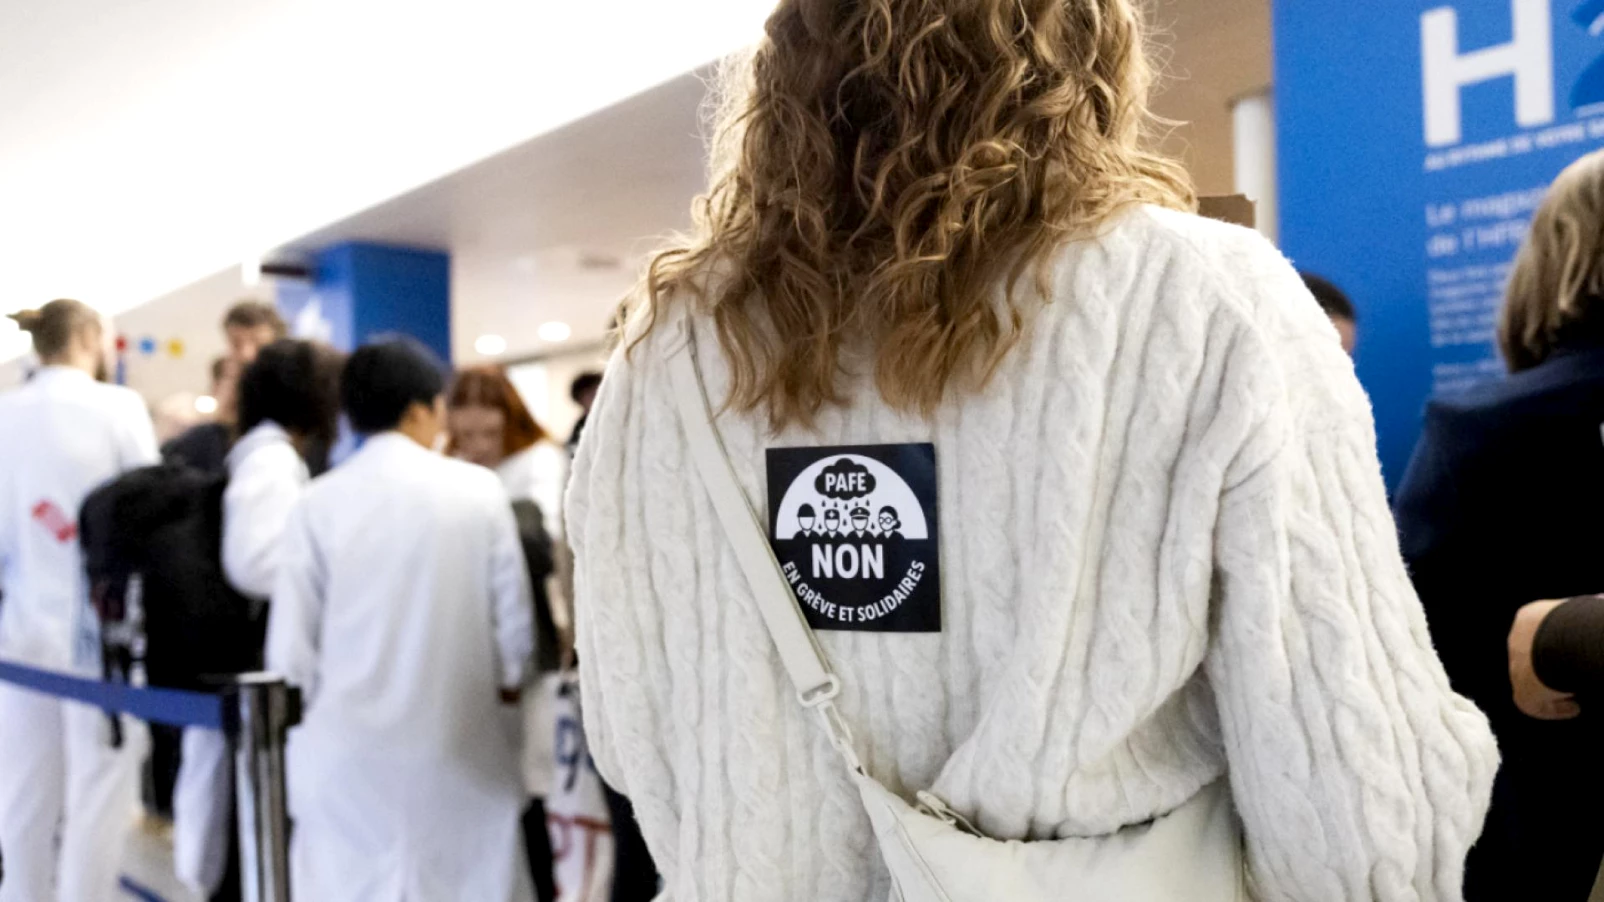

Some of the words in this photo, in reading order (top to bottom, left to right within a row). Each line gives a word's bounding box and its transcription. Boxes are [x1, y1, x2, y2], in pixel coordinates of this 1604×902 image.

[825, 472, 867, 492] PAFE
[811, 543, 884, 579] NON
[782, 561, 800, 584] EN
[797, 582, 836, 619] GRÈVE
[838, 607, 854, 622] ET
[857, 559, 925, 622] SOLIDAIRES
